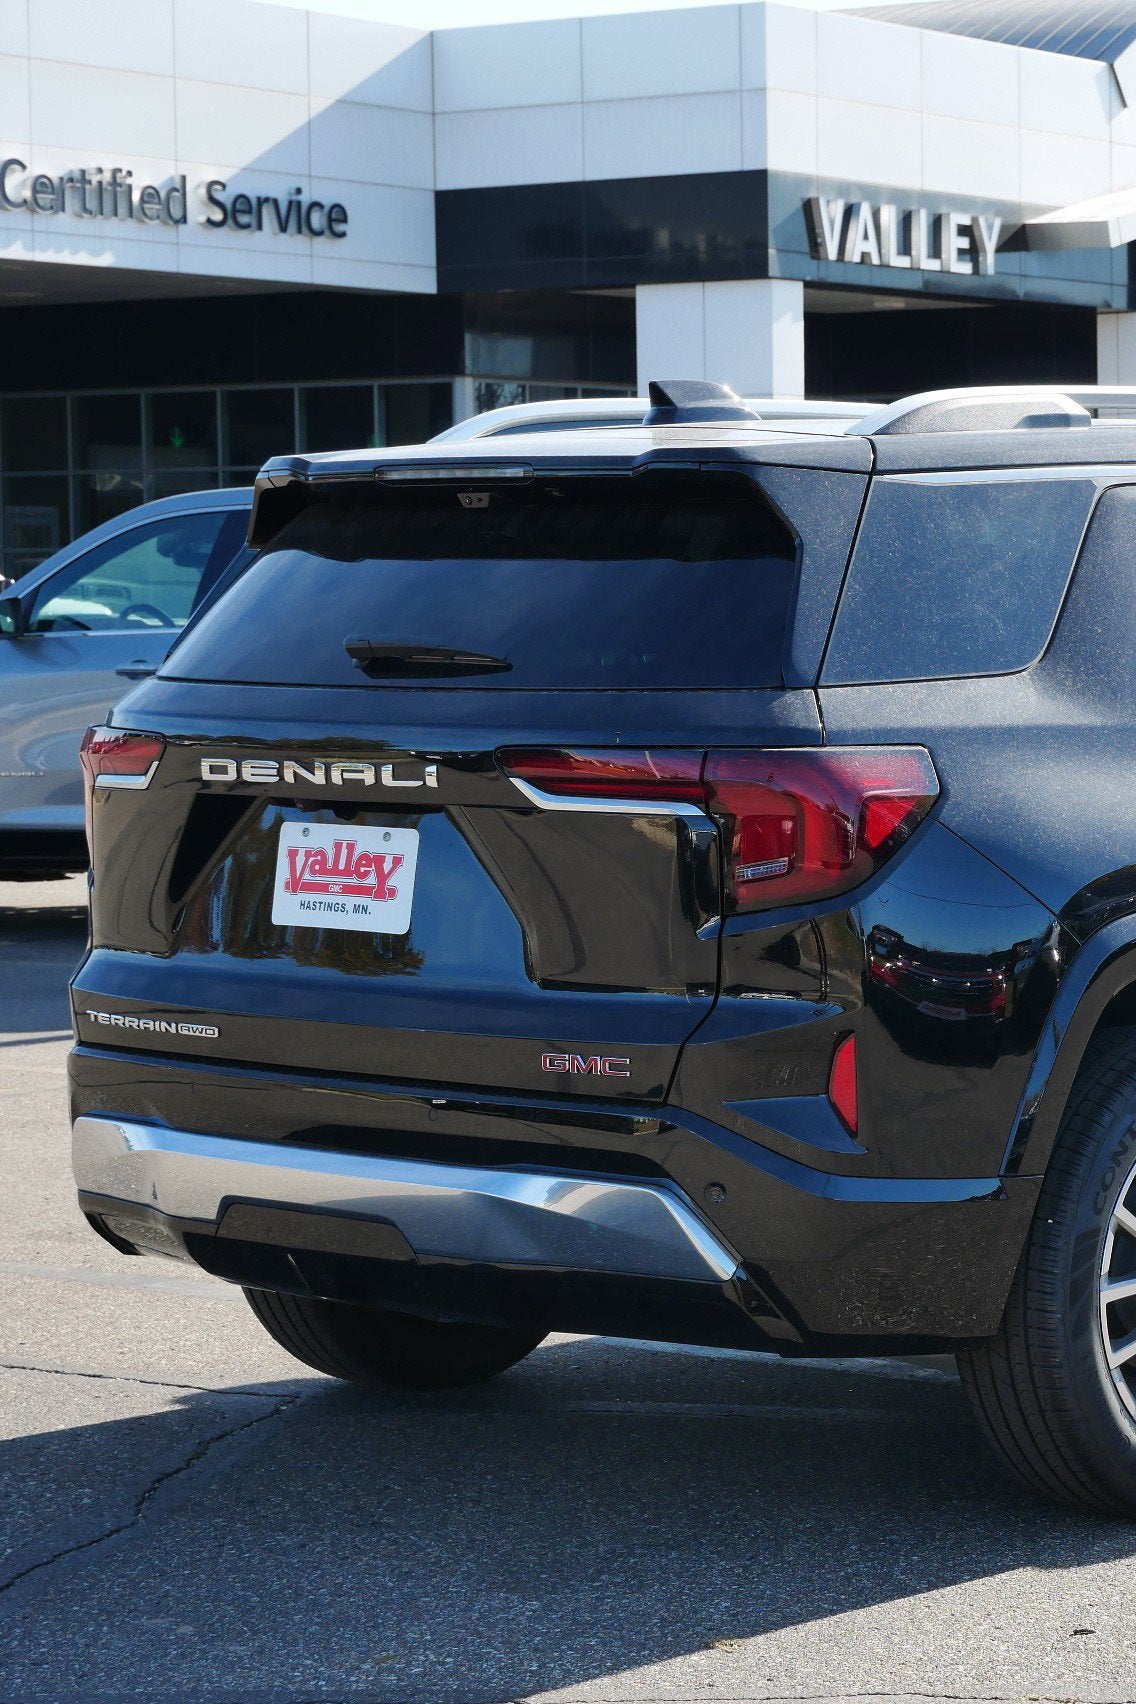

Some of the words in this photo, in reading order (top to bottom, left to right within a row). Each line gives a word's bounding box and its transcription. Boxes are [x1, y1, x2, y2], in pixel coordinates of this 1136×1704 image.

[0, 158, 188, 225] Certified
[206, 179, 348, 238] Service
[814, 197, 1002, 275] VALLEY
[201, 758, 438, 788] DENALI
[286, 839, 405, 902] Valley
[328, 884, 343, 893] GMC
[299, 900, 349, 915] HASTINGS,
[352, 904, 372, 915] MN.
[86, 1010, 178, 1034] TERRAIN
[541, 1053, 631, 1077] GMC
